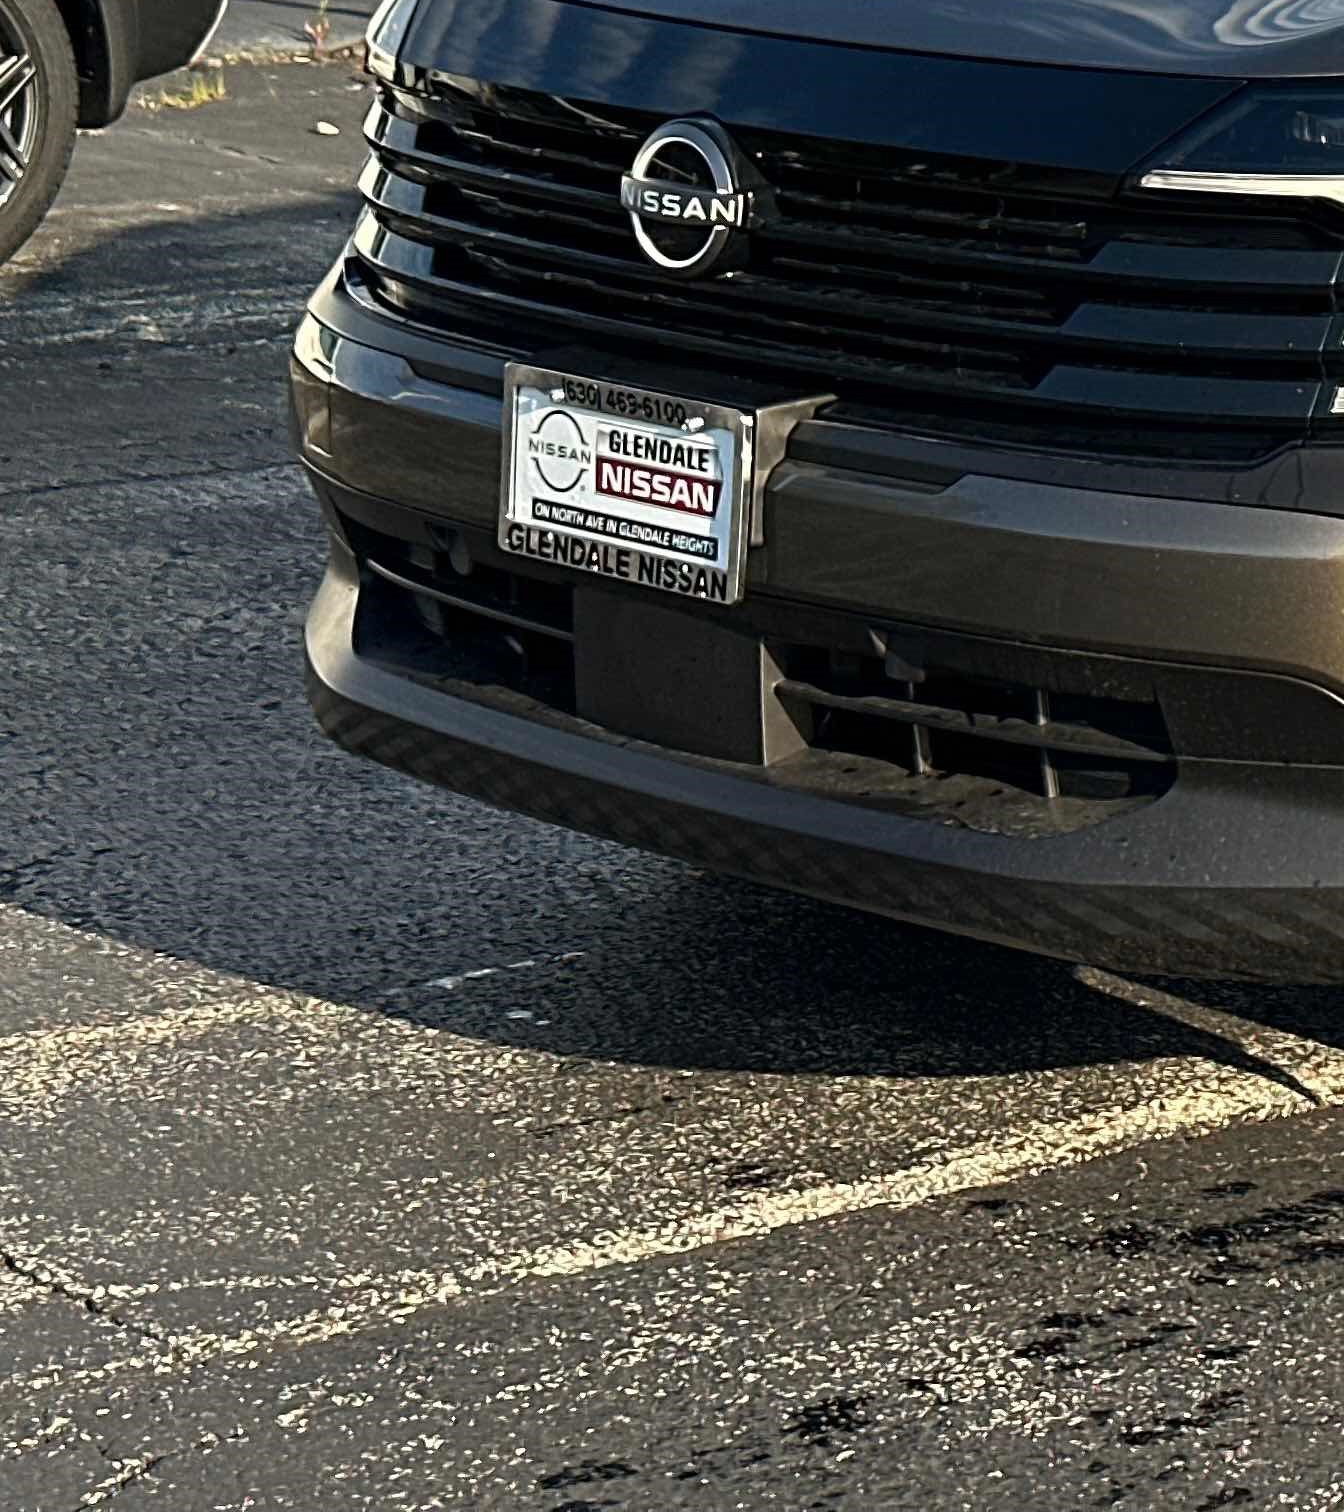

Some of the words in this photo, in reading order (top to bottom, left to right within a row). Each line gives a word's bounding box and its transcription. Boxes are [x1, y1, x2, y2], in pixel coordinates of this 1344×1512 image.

[621, 182, 736, 223] NISSAN
[528, 437, 592, 465] NISSAN
[608, 429, 711, 473] GLENDALE
[600, 462, 715, 513] NISSAN
[534, 502, 550, 519] ON
[551, 506, 584, 526] NORTH
[585, 514, 605, 531] AVE
[605, 519, 618, 534] IN
[619, 521, 671, 546] GLENDALE
[671, 533, 715, 556] HEIGHTS
[507, 522, 631, 579] GLENDALE
[638, 553, 728, 602] NISSAN
